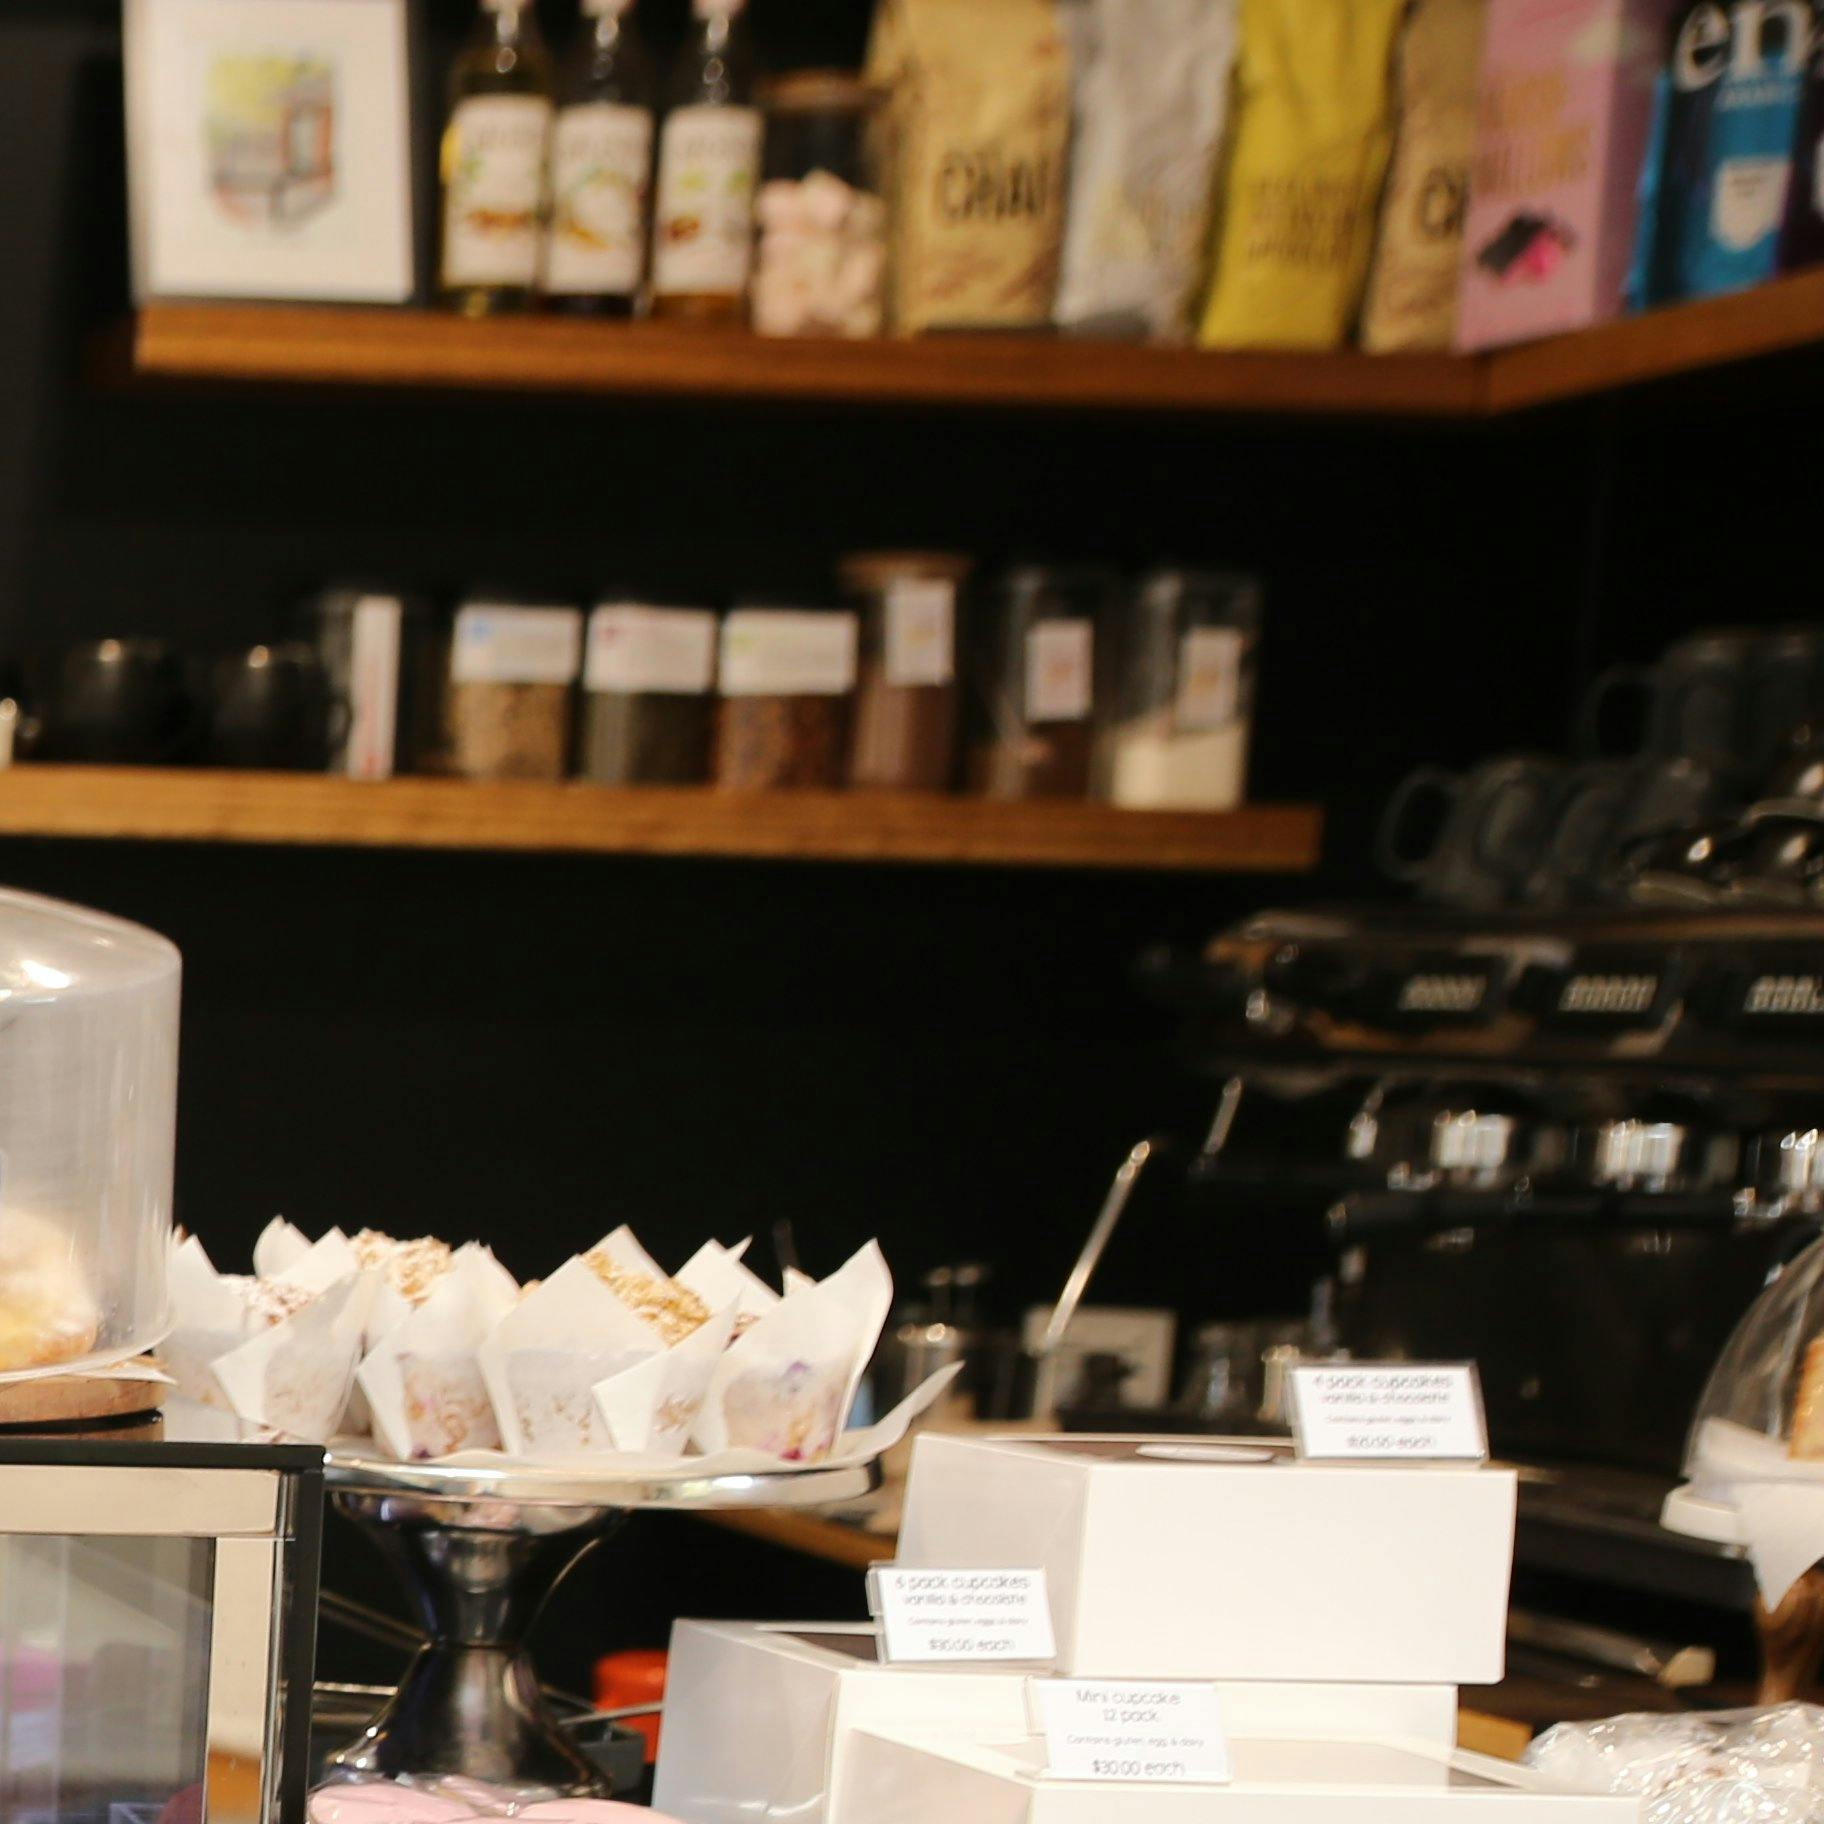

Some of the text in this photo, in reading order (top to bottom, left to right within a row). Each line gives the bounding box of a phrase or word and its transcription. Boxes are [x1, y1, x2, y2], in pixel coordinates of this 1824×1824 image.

[952, 1576, 1031, 1591] cupcakes
[1076, 1689, 1182, 1706] Mini cupcake
[1092, 1760, 1185, 1777] $30.00 each
